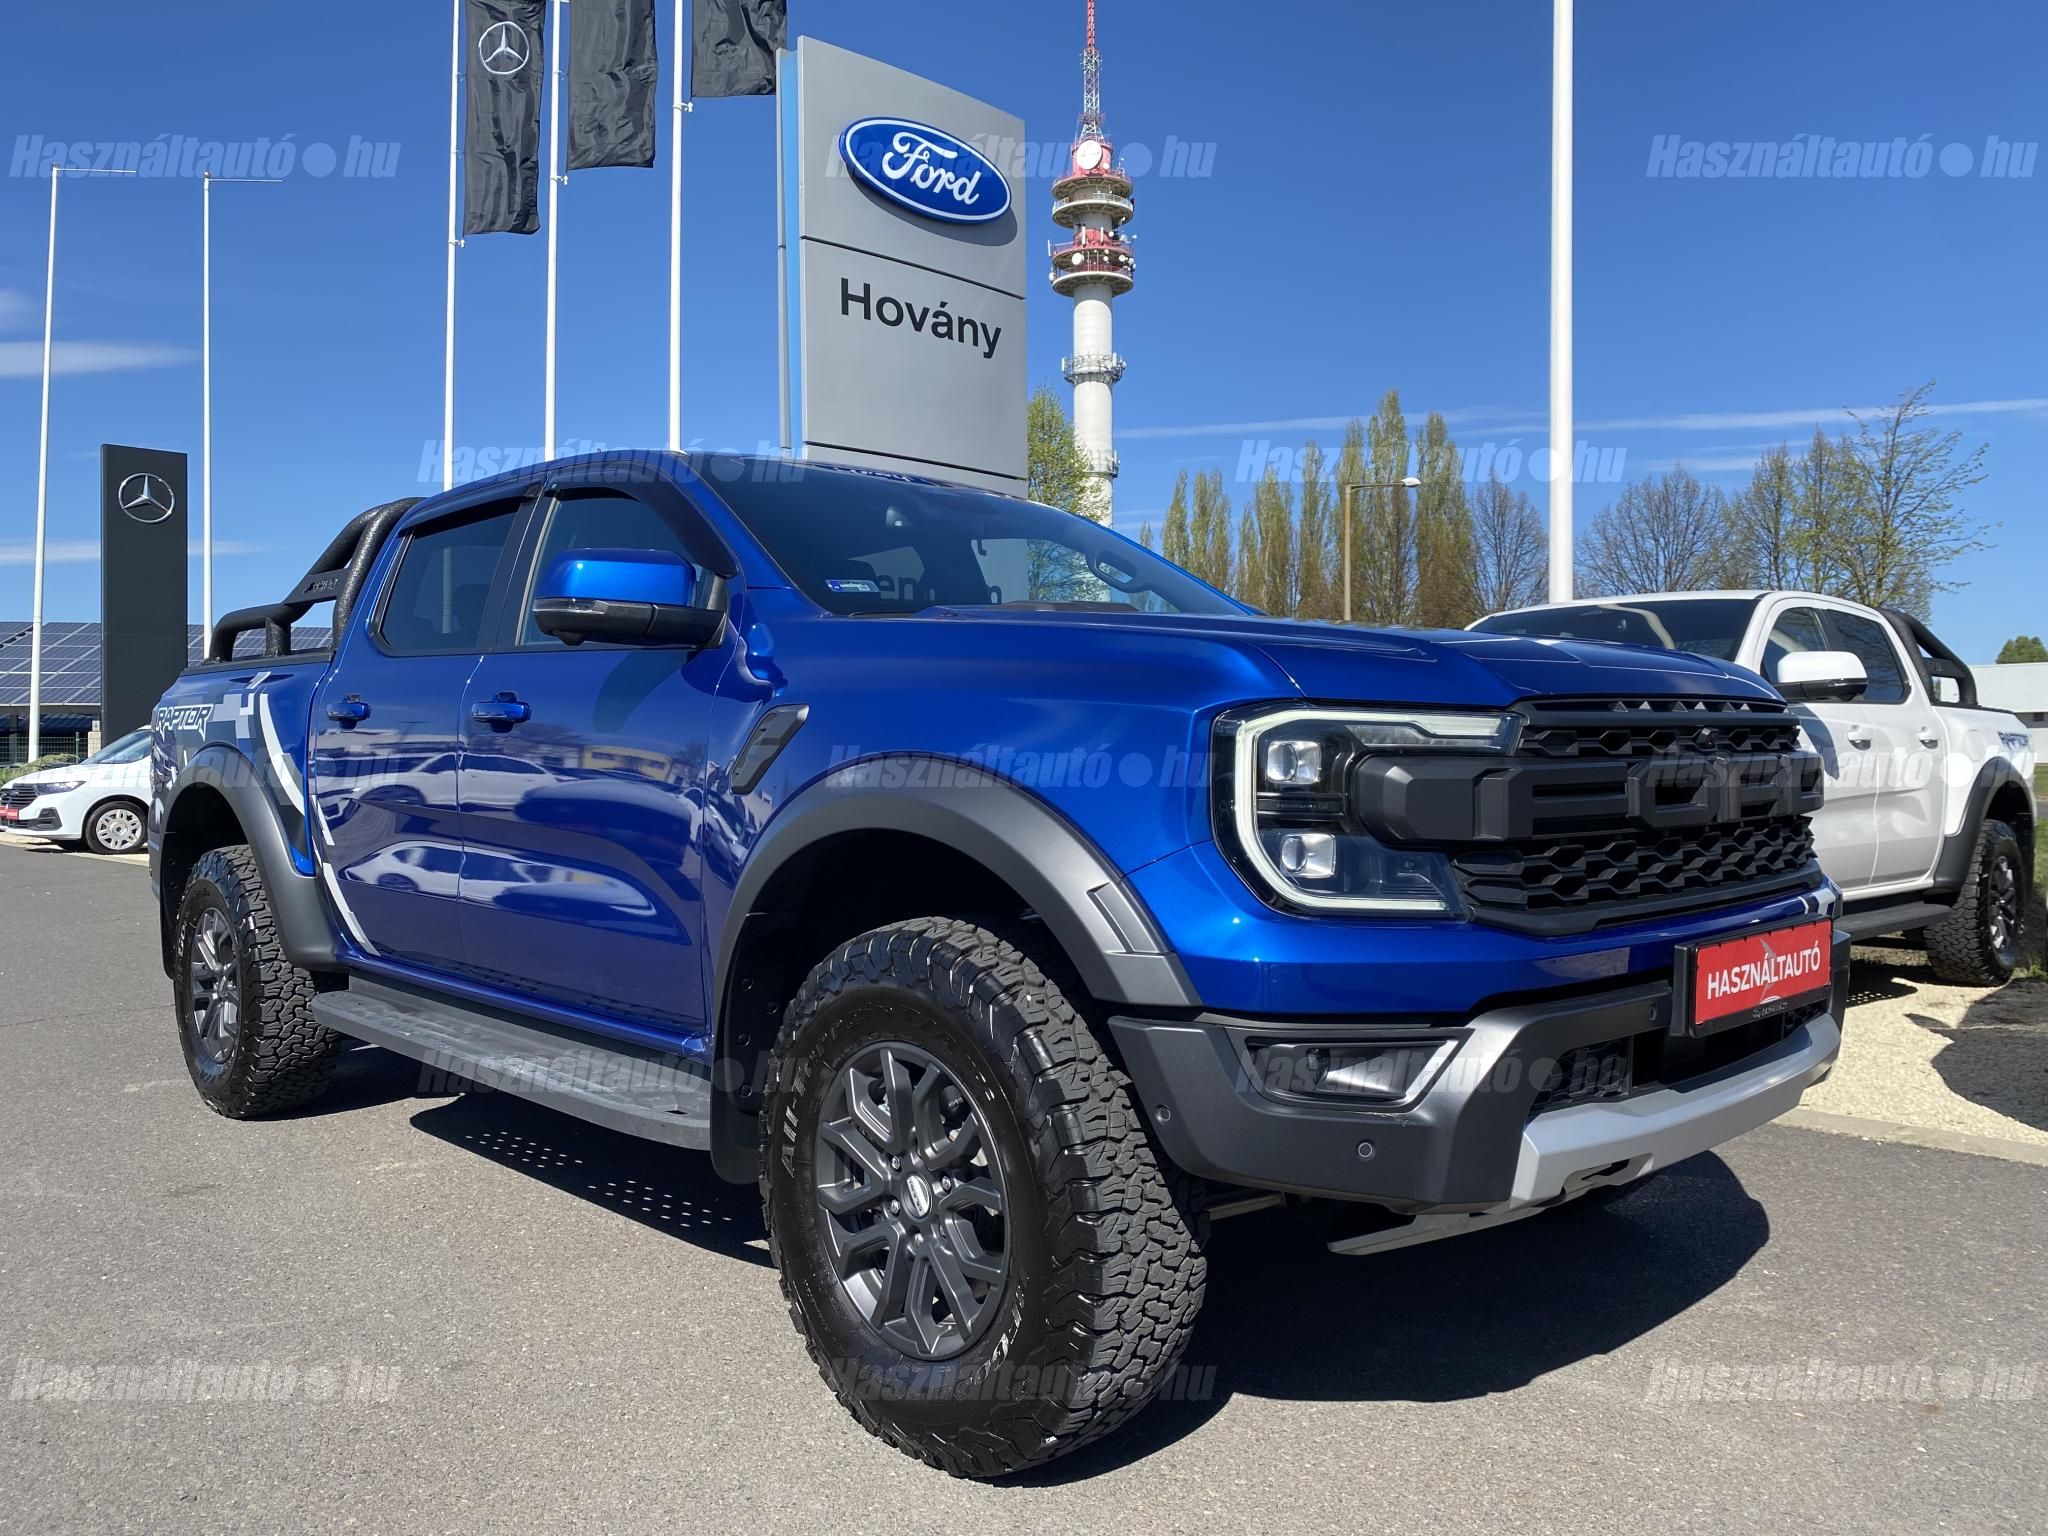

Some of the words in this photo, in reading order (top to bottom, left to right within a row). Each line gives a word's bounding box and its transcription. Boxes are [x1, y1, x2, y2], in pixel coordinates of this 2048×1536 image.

[882, 131, 958, 205] Ford
[841, 277, 1002, 359] Hovány
[156, 703, 213, 742] RAPTOR
[1707, 940, 1821, 1000] HASZNÁLTAUTÓ
